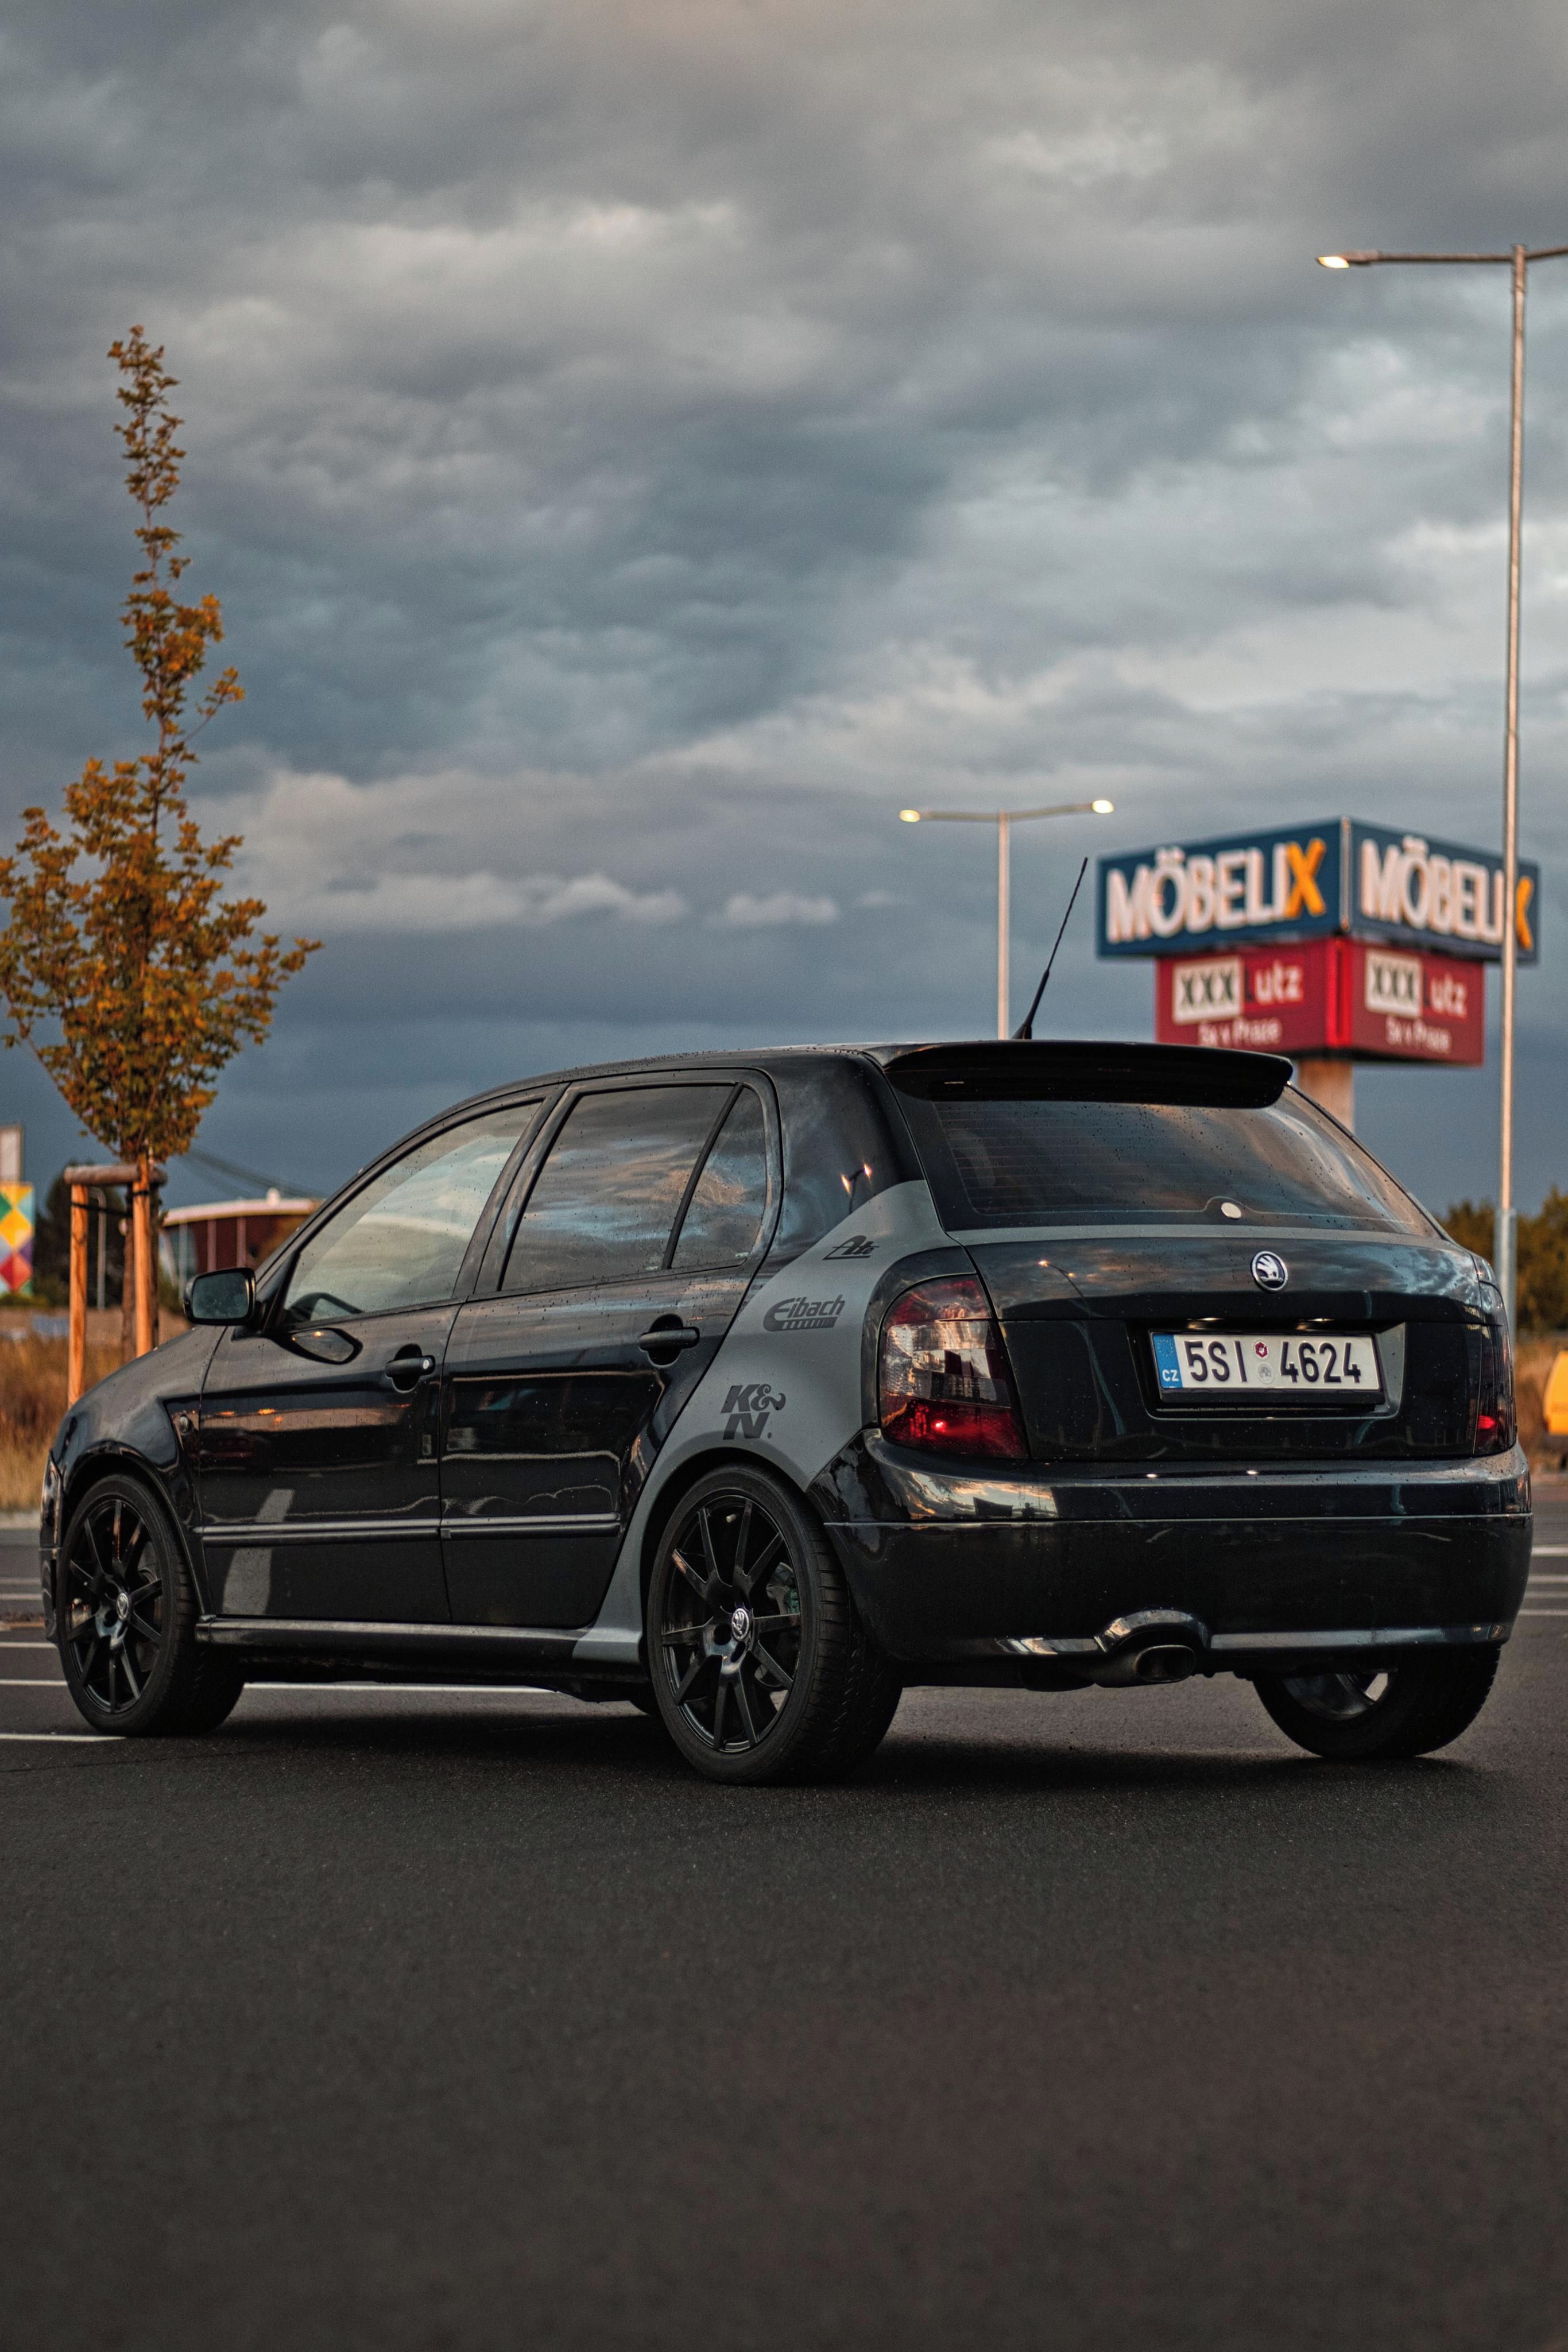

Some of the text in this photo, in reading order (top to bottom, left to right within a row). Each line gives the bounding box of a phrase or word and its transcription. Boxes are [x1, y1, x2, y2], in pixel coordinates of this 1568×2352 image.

[1106, 837, 1327, 944] MÖBELIX
[763, 1294, 845, 1332] Eibach
[1162, 1369, 1179, 1382] CZ
[1280, 1341, 1361, 1383] 4624
